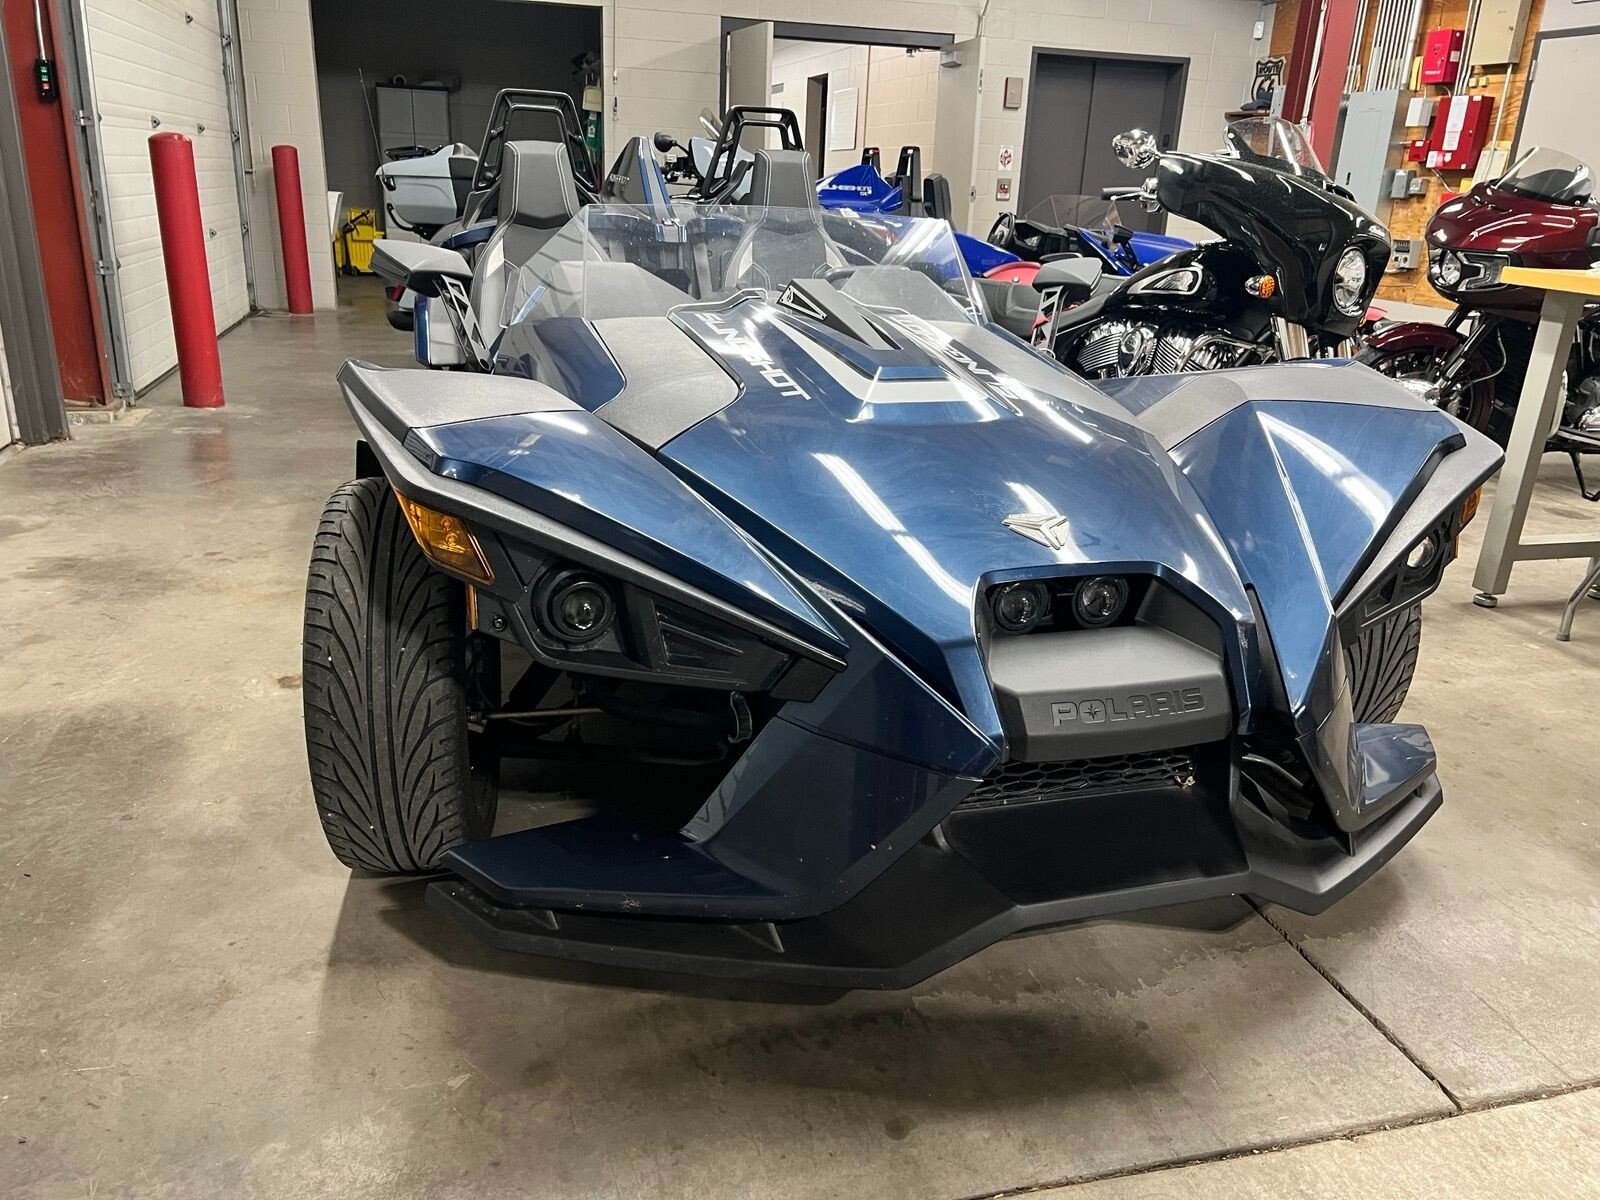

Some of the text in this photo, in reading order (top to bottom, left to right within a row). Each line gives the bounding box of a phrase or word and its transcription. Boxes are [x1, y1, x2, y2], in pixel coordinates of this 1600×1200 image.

[1258, 64, 1281, 74] ROUTE
[694, 312, 812, 401] SLINGSHOT
[1050, 687, 1206, 727] POLARIS
